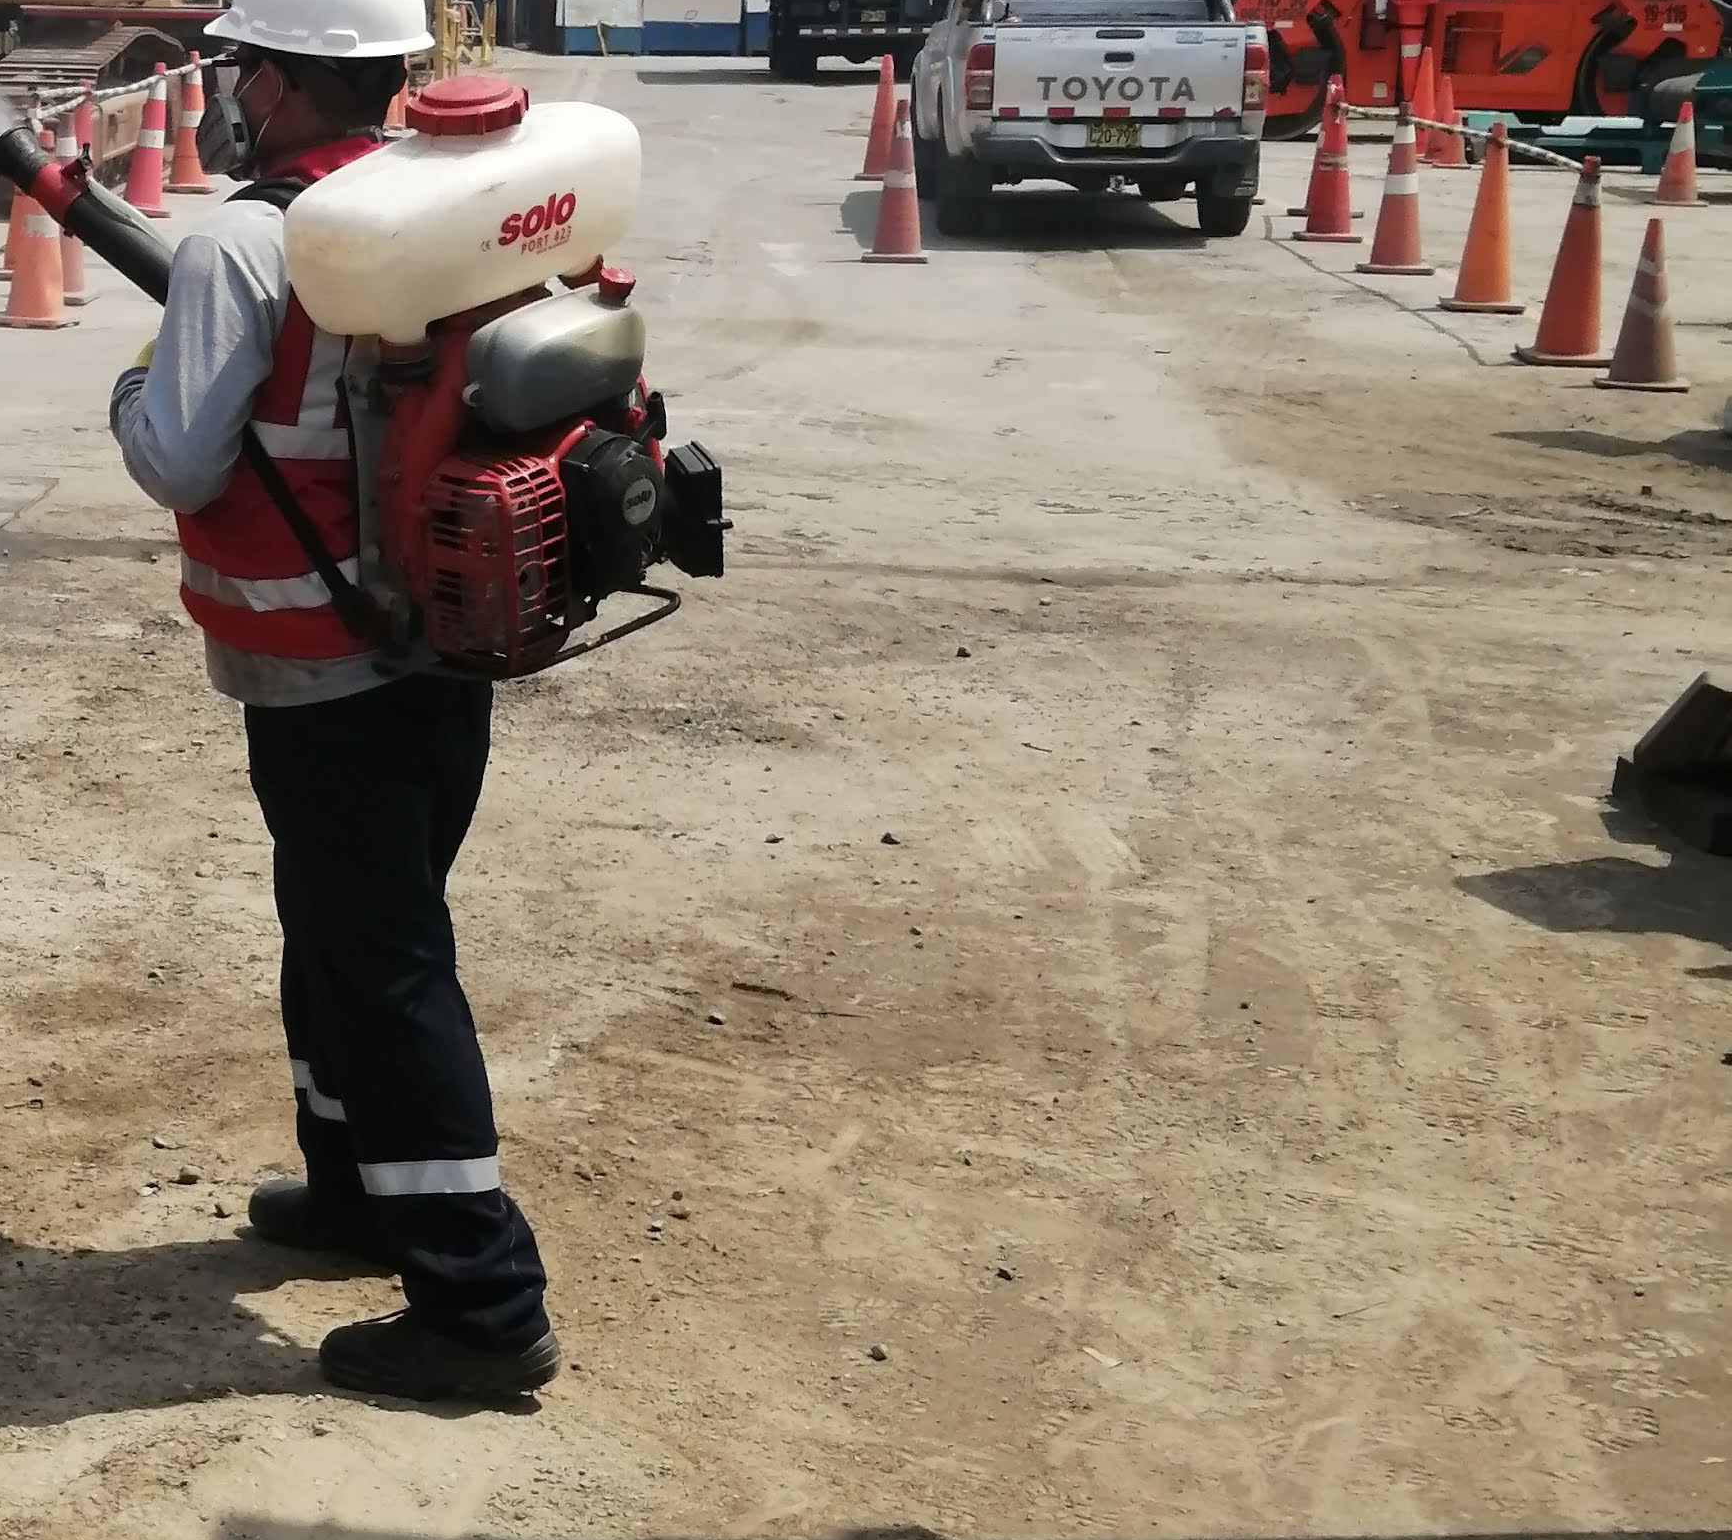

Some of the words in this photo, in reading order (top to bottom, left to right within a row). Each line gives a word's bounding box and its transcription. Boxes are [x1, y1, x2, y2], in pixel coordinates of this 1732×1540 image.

[1036, 76, 1196, 102] TOYOTA
[498, 192, 576, 246] solo
[521, 234, 549, 255] PORT
